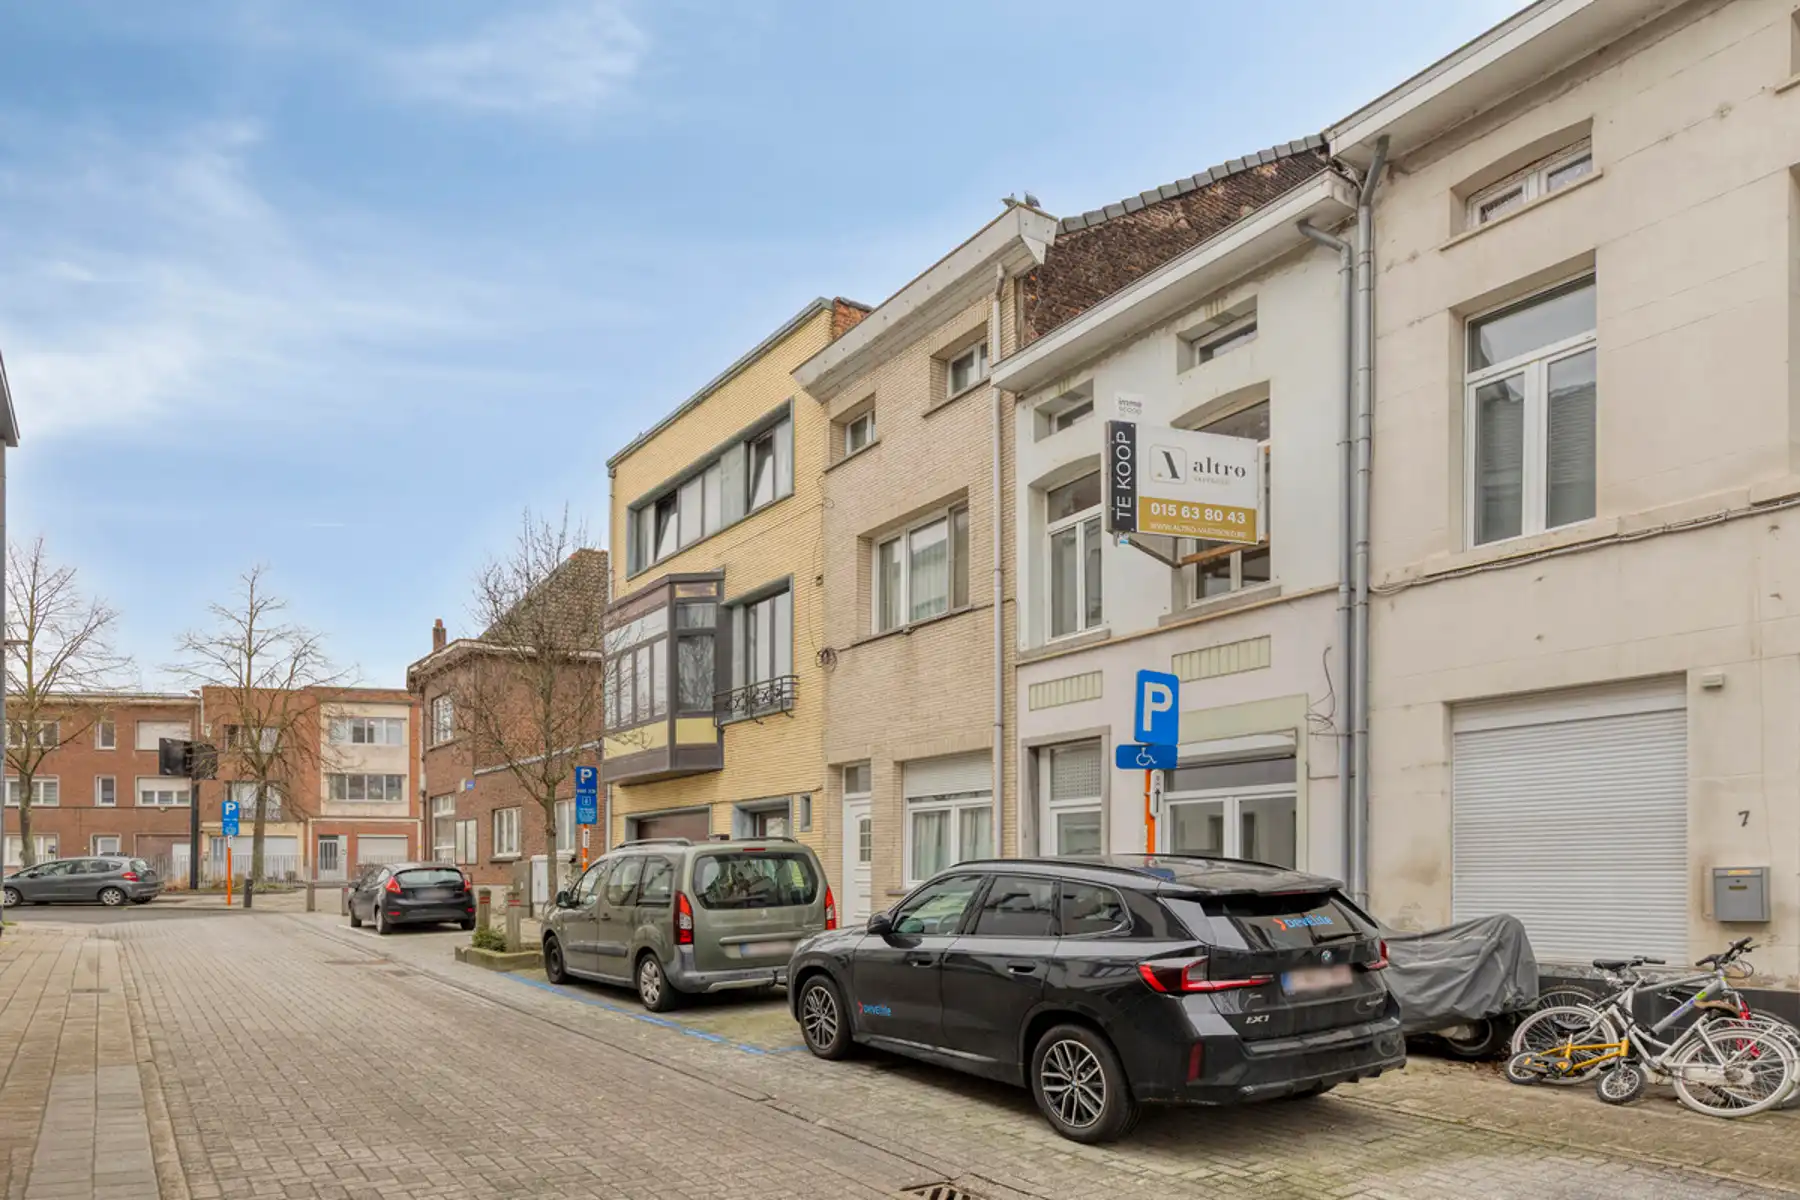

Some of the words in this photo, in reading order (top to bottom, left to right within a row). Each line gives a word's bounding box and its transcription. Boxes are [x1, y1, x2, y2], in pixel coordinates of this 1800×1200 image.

[1116, 431, 1132, 490] KOOP
[1193, 457, 1246, 478] altro
[1116, 496, 1132, 520] TE
[1150, 502, 1177, 517] 015
[1181, 505, 1200, 519] 63
[1204, 507, 1224, 522] 80
[1227, 511, 1246, 524] 43
[1143, 682, 1173, 732] P
[581, 768, 592, 784] P
[225, 803, 236, 815] P
[1738, 810, 1750, 828] 7
